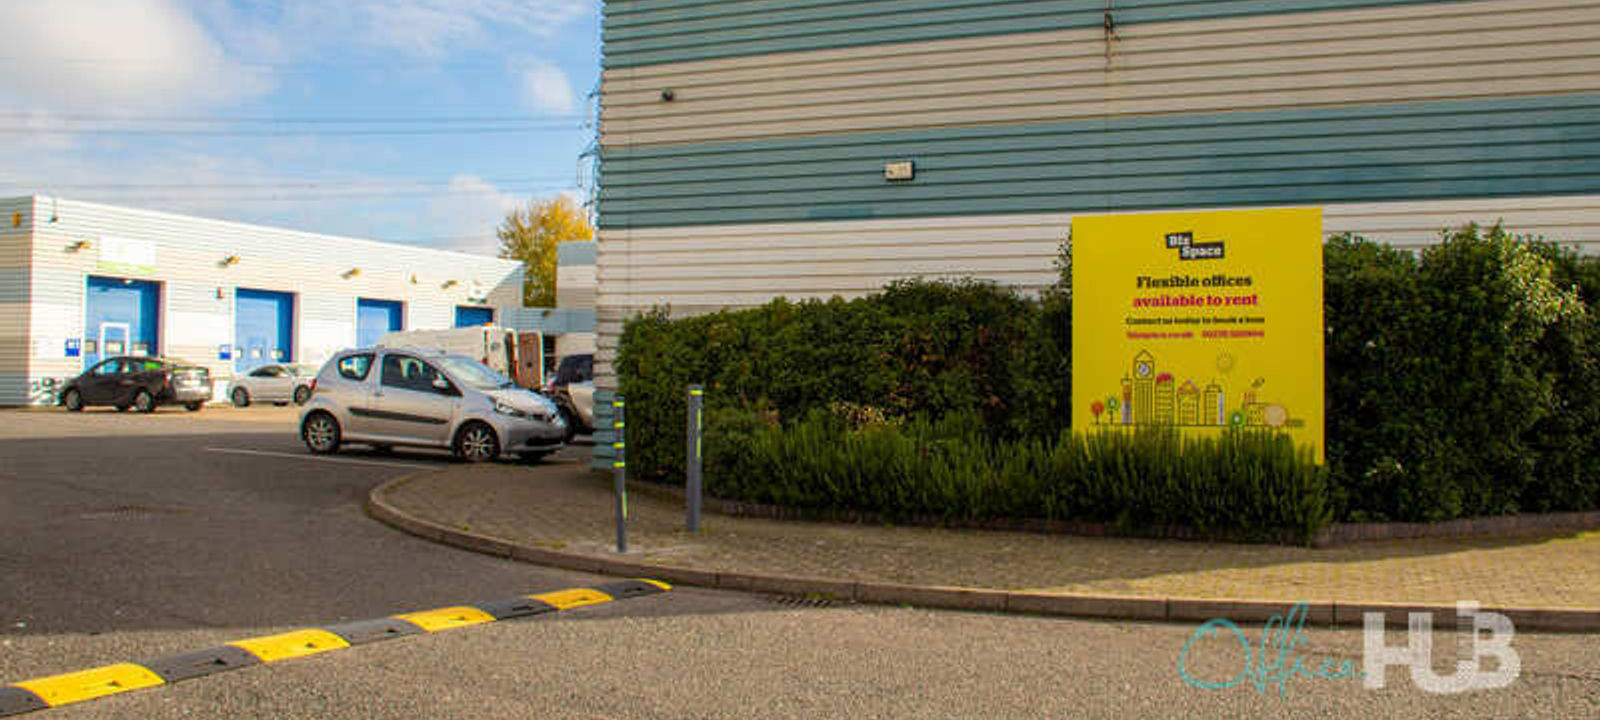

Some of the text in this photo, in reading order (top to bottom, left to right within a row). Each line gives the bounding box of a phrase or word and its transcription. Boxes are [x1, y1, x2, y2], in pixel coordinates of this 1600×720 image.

[1168, 235, 1190, 246] Biz
[1181, 246, 1222, 259] Space
[1136, 274, 1252, 288] Flexible offices
[1133, 294, 1258, 307] available to rent
